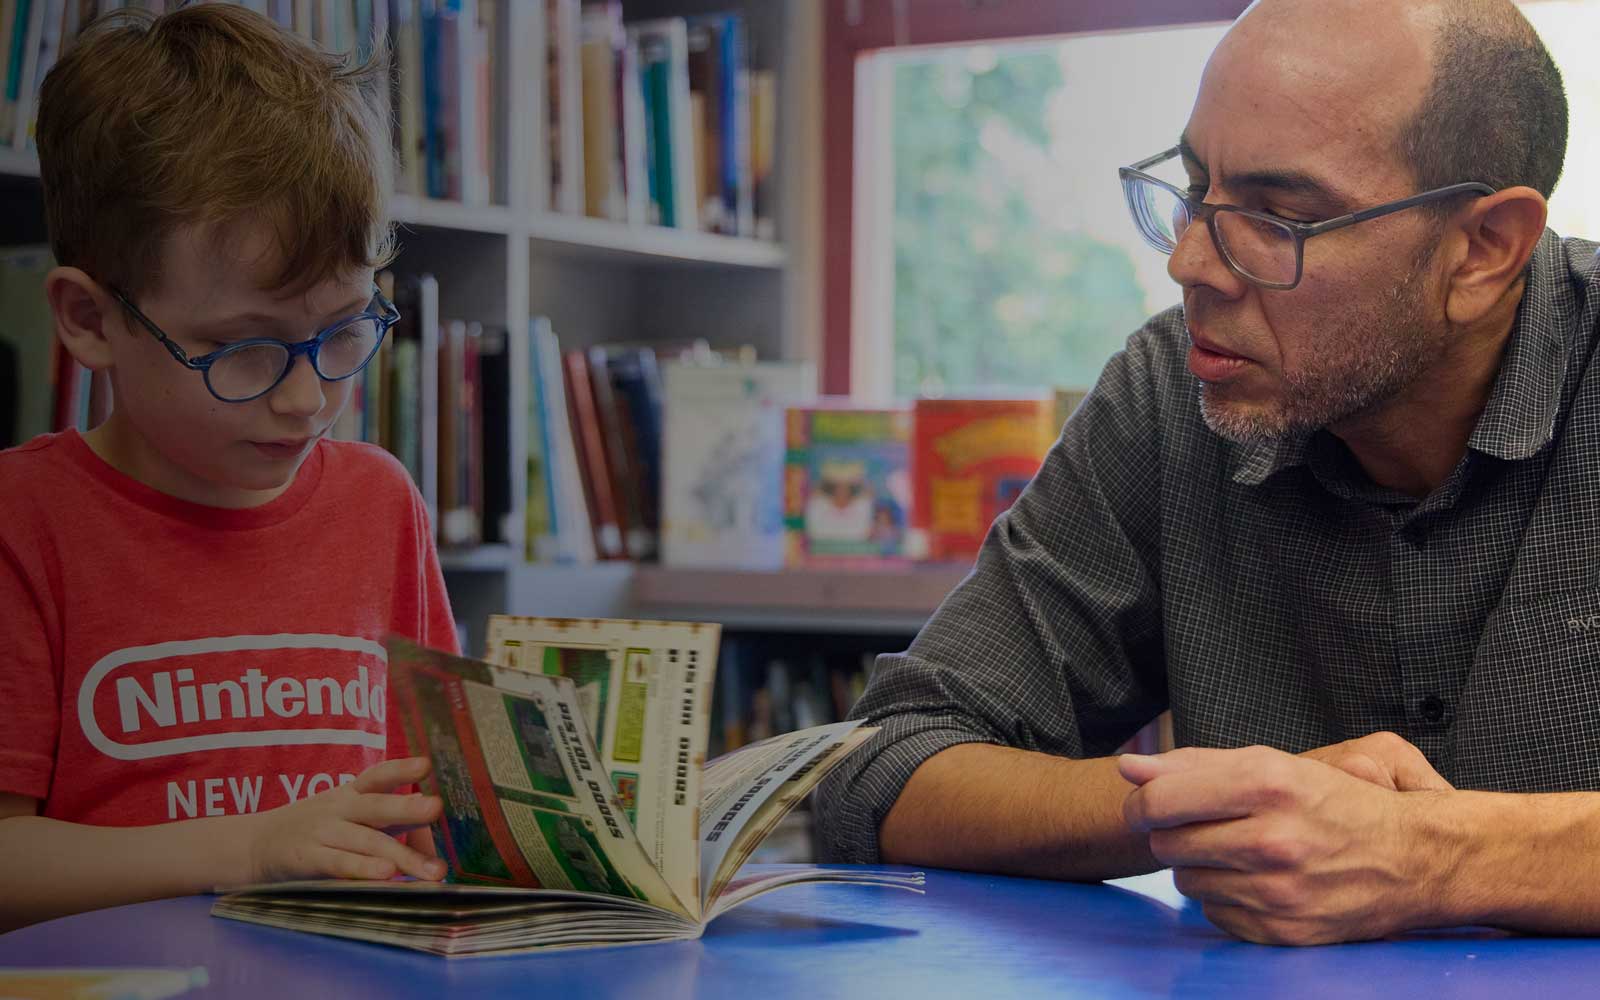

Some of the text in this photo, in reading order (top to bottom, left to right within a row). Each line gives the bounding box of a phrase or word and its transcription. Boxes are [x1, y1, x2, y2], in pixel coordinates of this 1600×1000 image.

[116, 665, 387, 733] Nintendo
[167, 776, 263, 819] NEW
[558, 702, 624, 840] PISTON DOORS
[674, 737, 690, 805] DOORS
[706, 779, 771, 842] SOURCES
